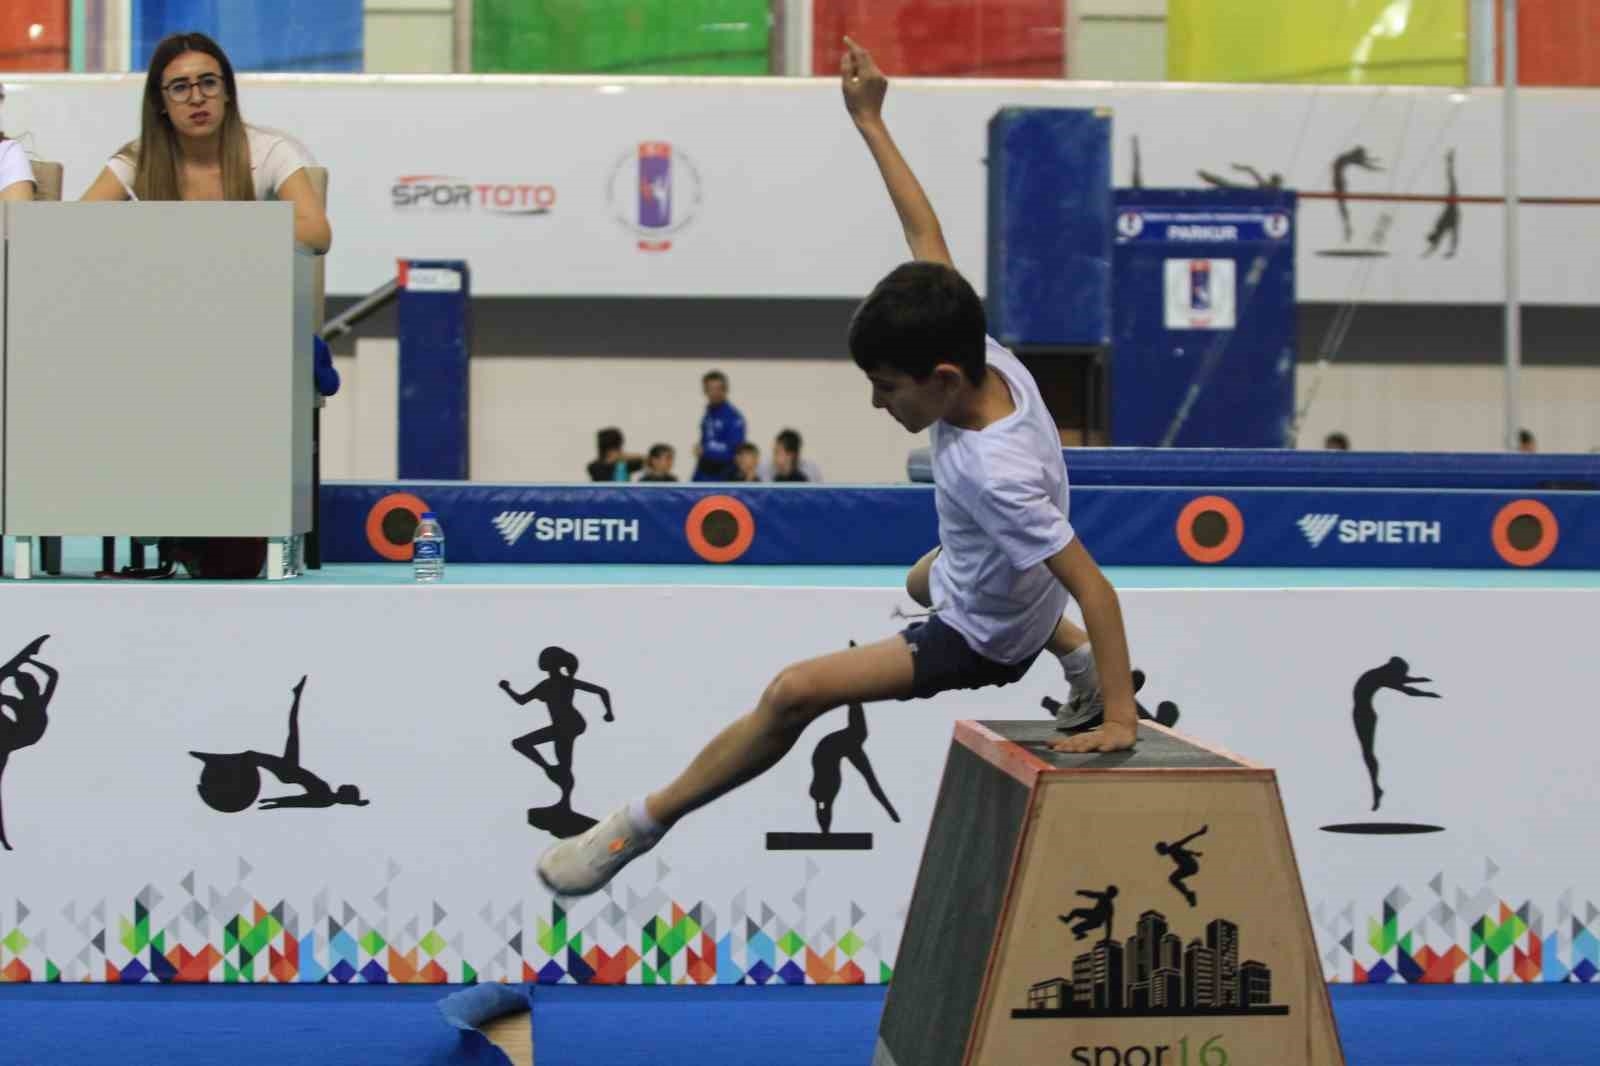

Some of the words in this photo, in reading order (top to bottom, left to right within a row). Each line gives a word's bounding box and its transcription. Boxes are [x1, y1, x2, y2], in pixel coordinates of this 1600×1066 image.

[1167, 225, 1238, 241] PARKUR
[535, 517, 639, 541] SPIETH
[1338, 519, 1441, 543] SPIETH
